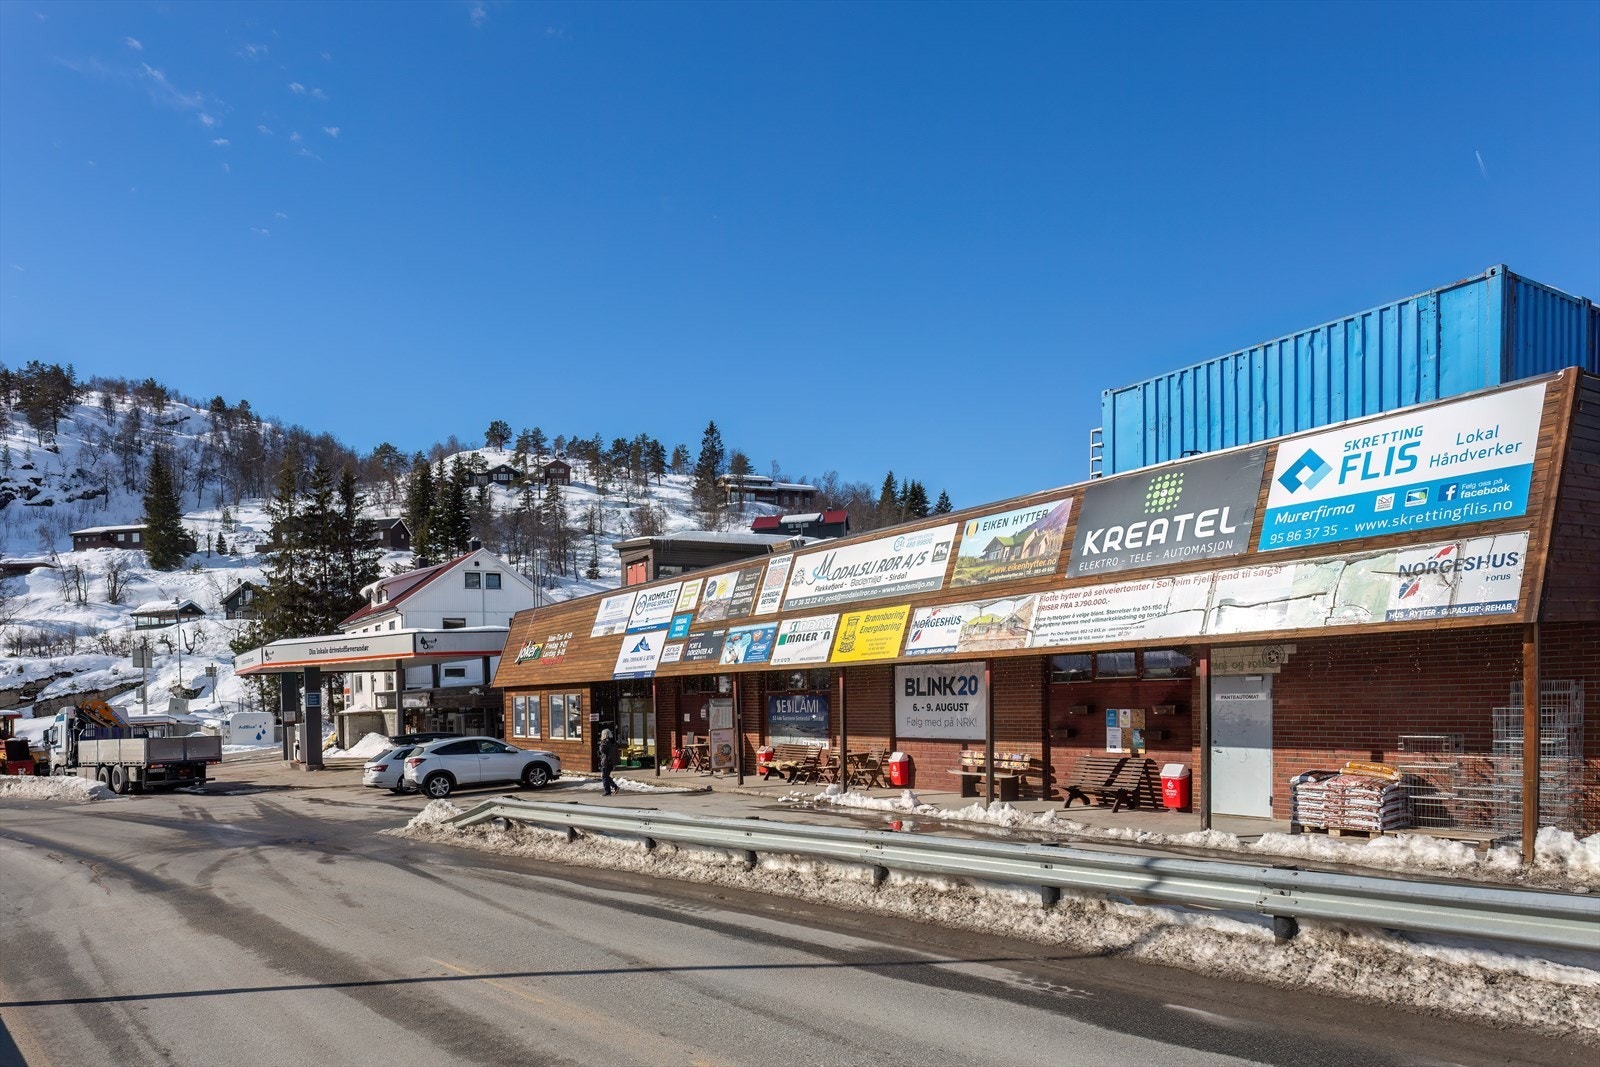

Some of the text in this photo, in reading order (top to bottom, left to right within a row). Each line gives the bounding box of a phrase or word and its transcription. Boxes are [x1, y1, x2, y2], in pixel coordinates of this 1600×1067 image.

[1344, 425, 1424, 452] SKRETTING
[1456, 425, 1499, 446] Lokal
[1338, 441, 1421, 484] FLIS
[1429, 441, 1523, 468] Håndverker
[1460, 483, 1511, 499] facebook
[1461, 478, 1503, 491] Følg oss på
[982, 508, 1049, 532] EIKEN HYTTER
[1270, 533, 1285, 545] 95
[1287, 530, 1302, 542] 86
[1304, 527, 1319, 540] 37
[1321, 525, 1338, 537] 35
[1354, 500, 1513, 533] www.skrettingflis.no
[1274, 503, 1355, 525] Murerfirma
[1082, 506, 1236, 556] KREATEL
[878, 556, 900, 572] RØR
[903, 551, 929, 570] A/S
[1079, 557, 1119, 571] ELEKTRO
[1129, 550, 1152, 562] TELE
[1163, 540, 1234, 559] AUTOMASJON
[1398, 551, 1519, 577] NORGESHUS
[990, 559, 1056, 575] www.eikenhytter.no
[815, 582, 844, 593] Flekkefjord
[889, 572, 908, 582] Sirdal
[1040, 594, 1059, 602] Flotte
[1060, 591, 1082, 601] hytter
[1083, 590, 1092, 599] på
[1094, 583, 1150, 596] selveiertomter
[1241, 569, 1251, 579] til
[648, 589, 678, 601] KOMPLETT
[1037, 603, 1059, 611] PRISER
[1074, 597, 1110, 608] 3.790.000,-
[1389, 611, 1404, 620] HUS
[1485, 602, 1513, 613] REHAB
[859, 621, 902, 635] Energiboring
[913, 615, 962, 630] NORGESHUS
[912, 703, 920, 712] 6.
[926, 703, 933, 712] 9.
[935, 702, 969, 712] AUGUST
[906, 716, 978, 729] Følg med på NRK!
